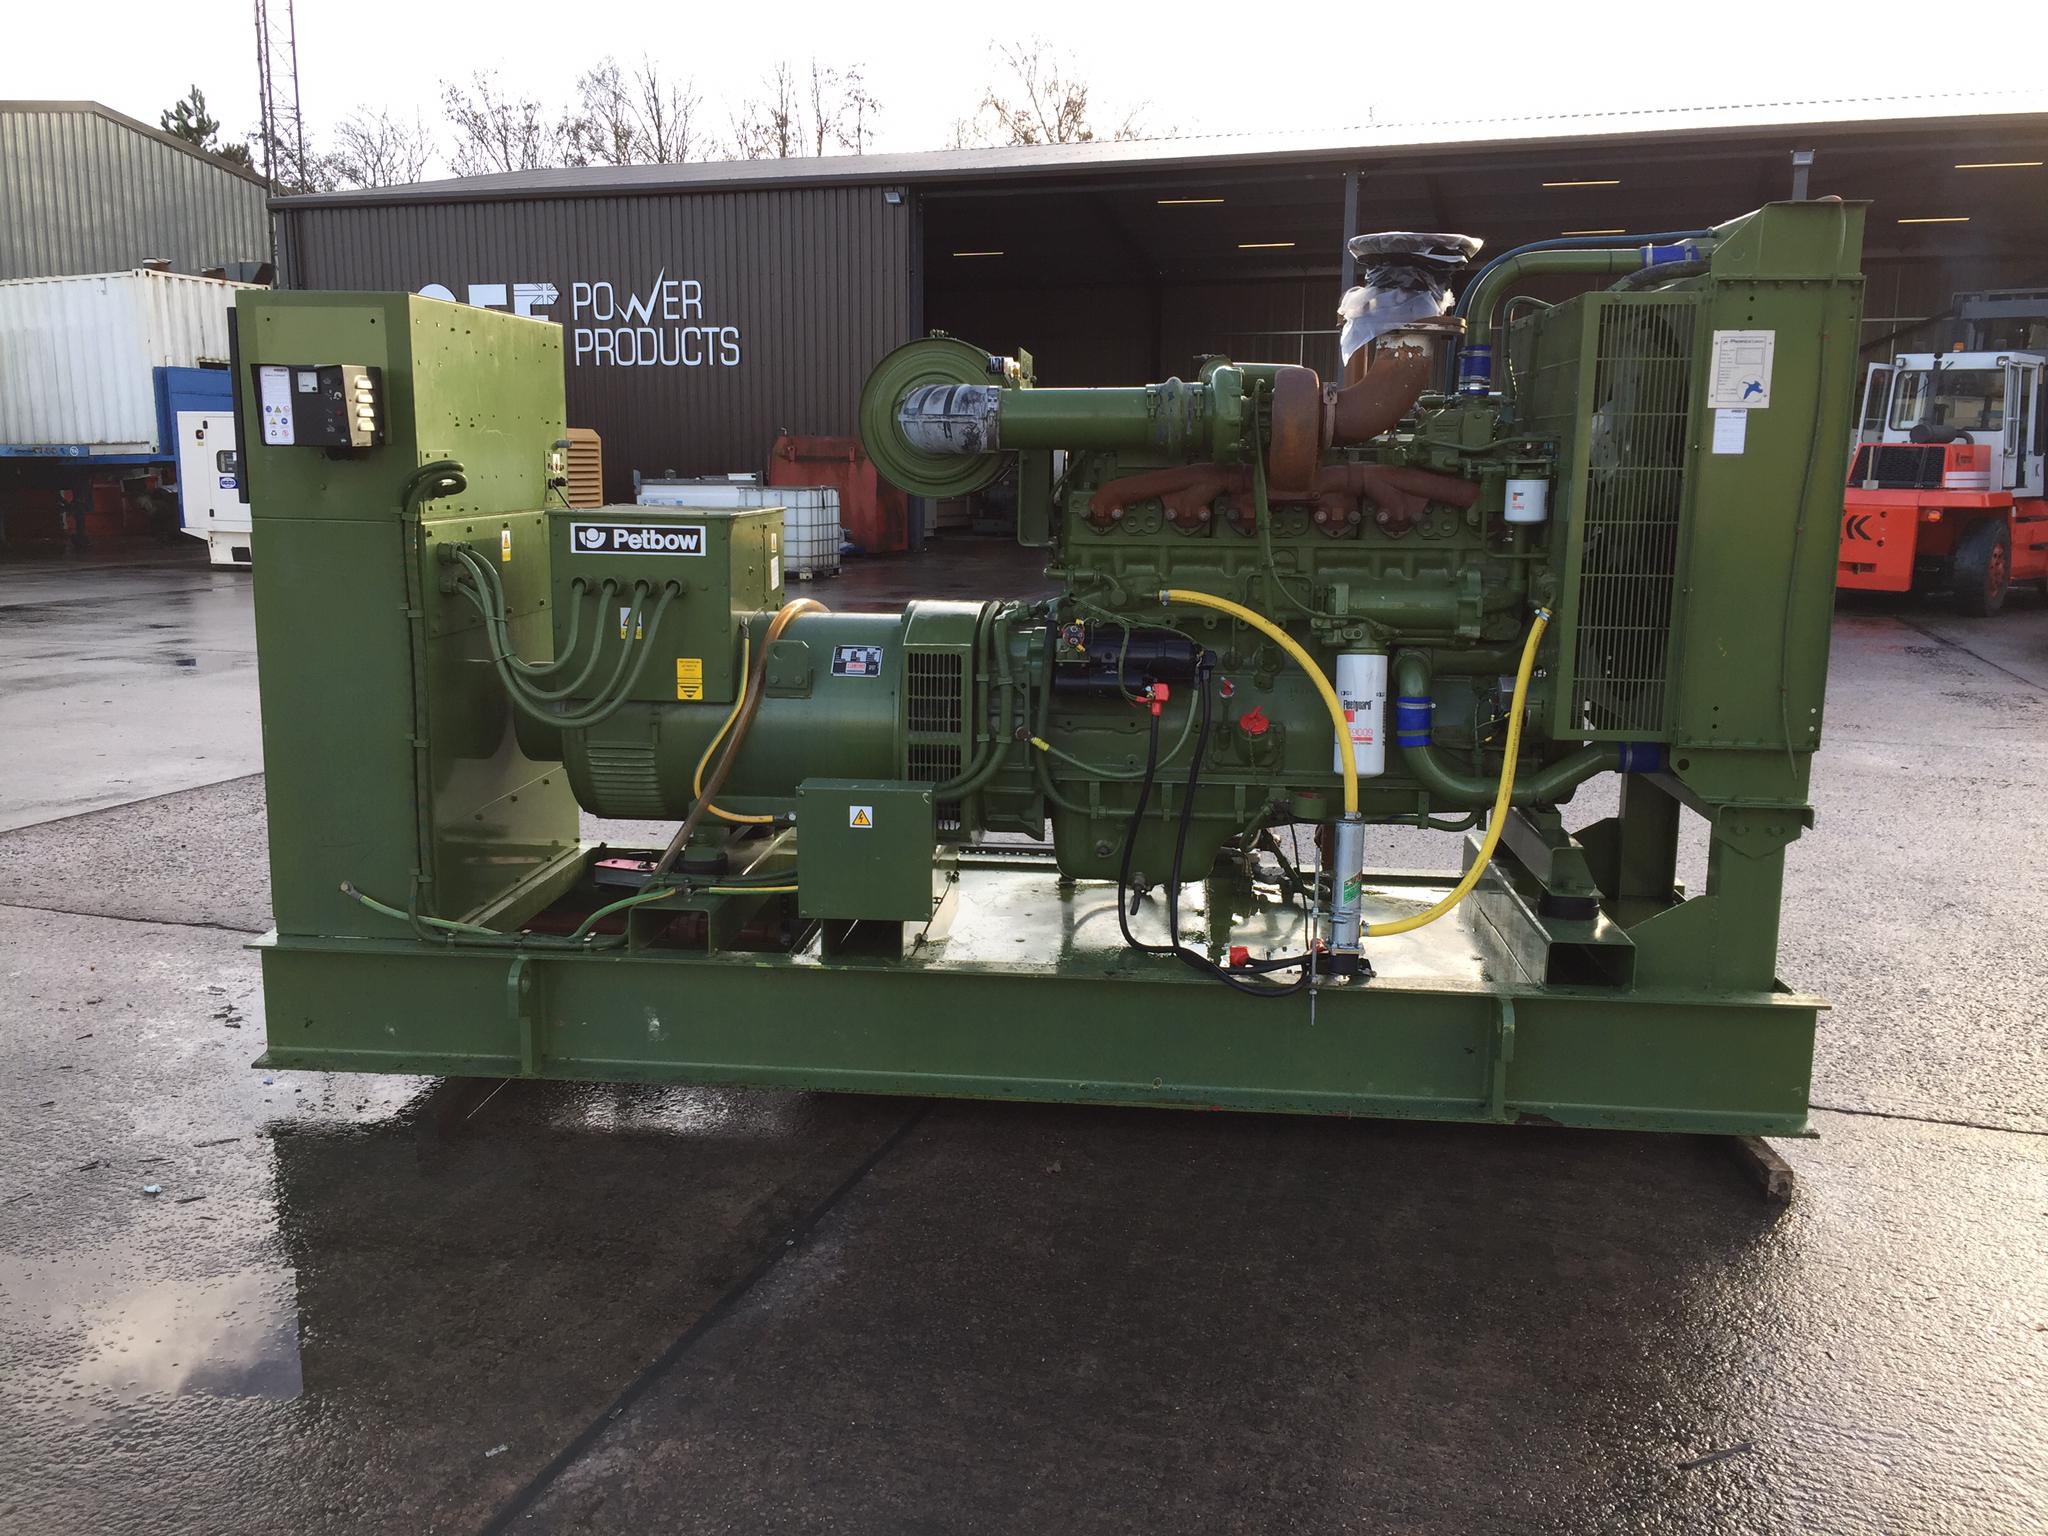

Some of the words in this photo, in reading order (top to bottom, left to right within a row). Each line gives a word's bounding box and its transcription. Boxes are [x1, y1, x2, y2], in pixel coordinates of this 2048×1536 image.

[572, 267, 703, 326] POWER
[574, 327, 740, 367] PRODUCTS
[613, 528, 699, 550] Petbow
